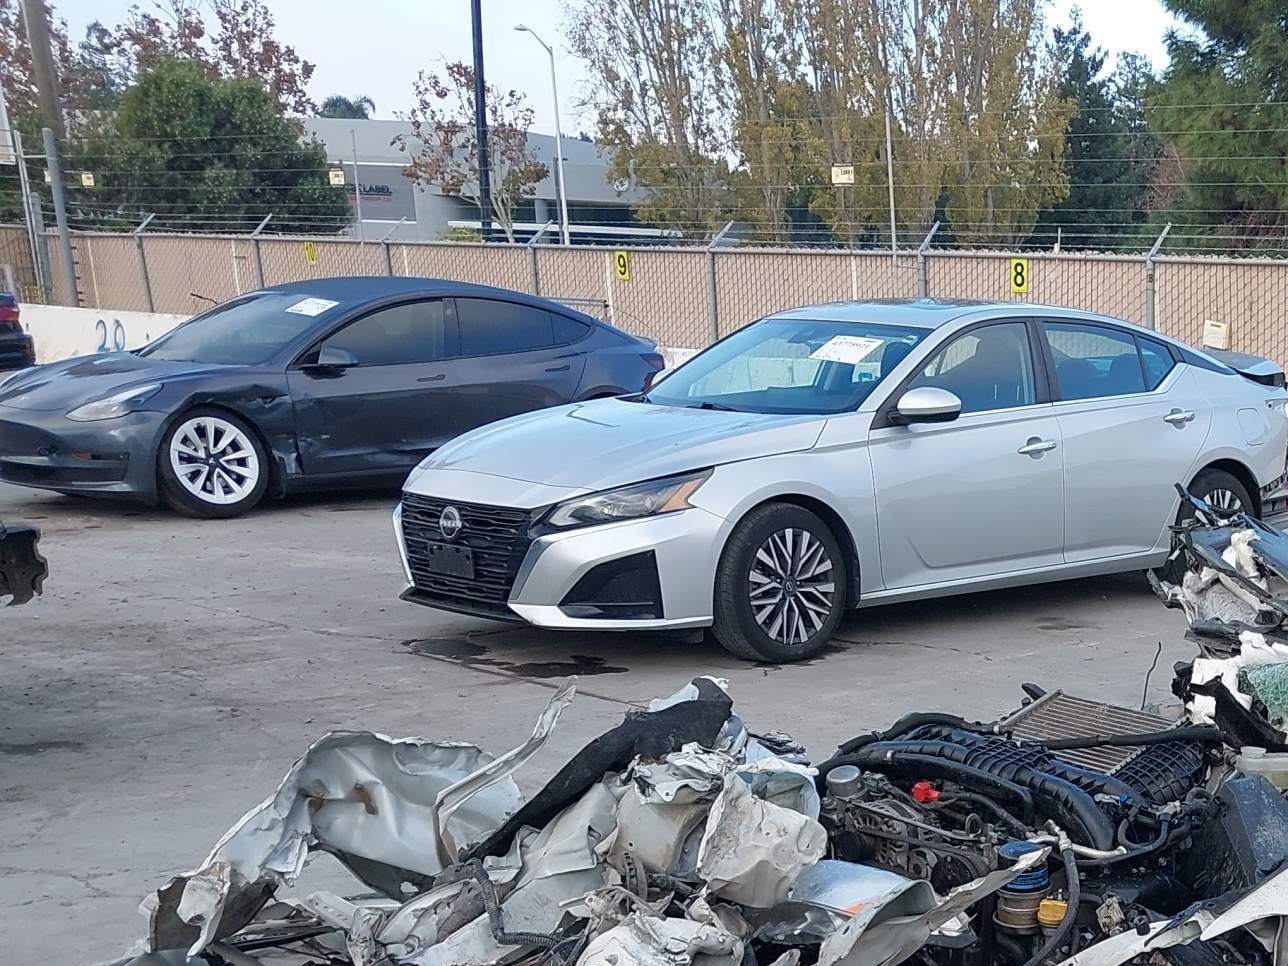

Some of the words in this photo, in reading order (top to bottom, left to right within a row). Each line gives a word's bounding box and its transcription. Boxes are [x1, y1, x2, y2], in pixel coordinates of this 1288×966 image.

[617, 254, 627, 276] 9
[1013, 262, 1025, 288] 8
[95, 318, 126, 353] 20
